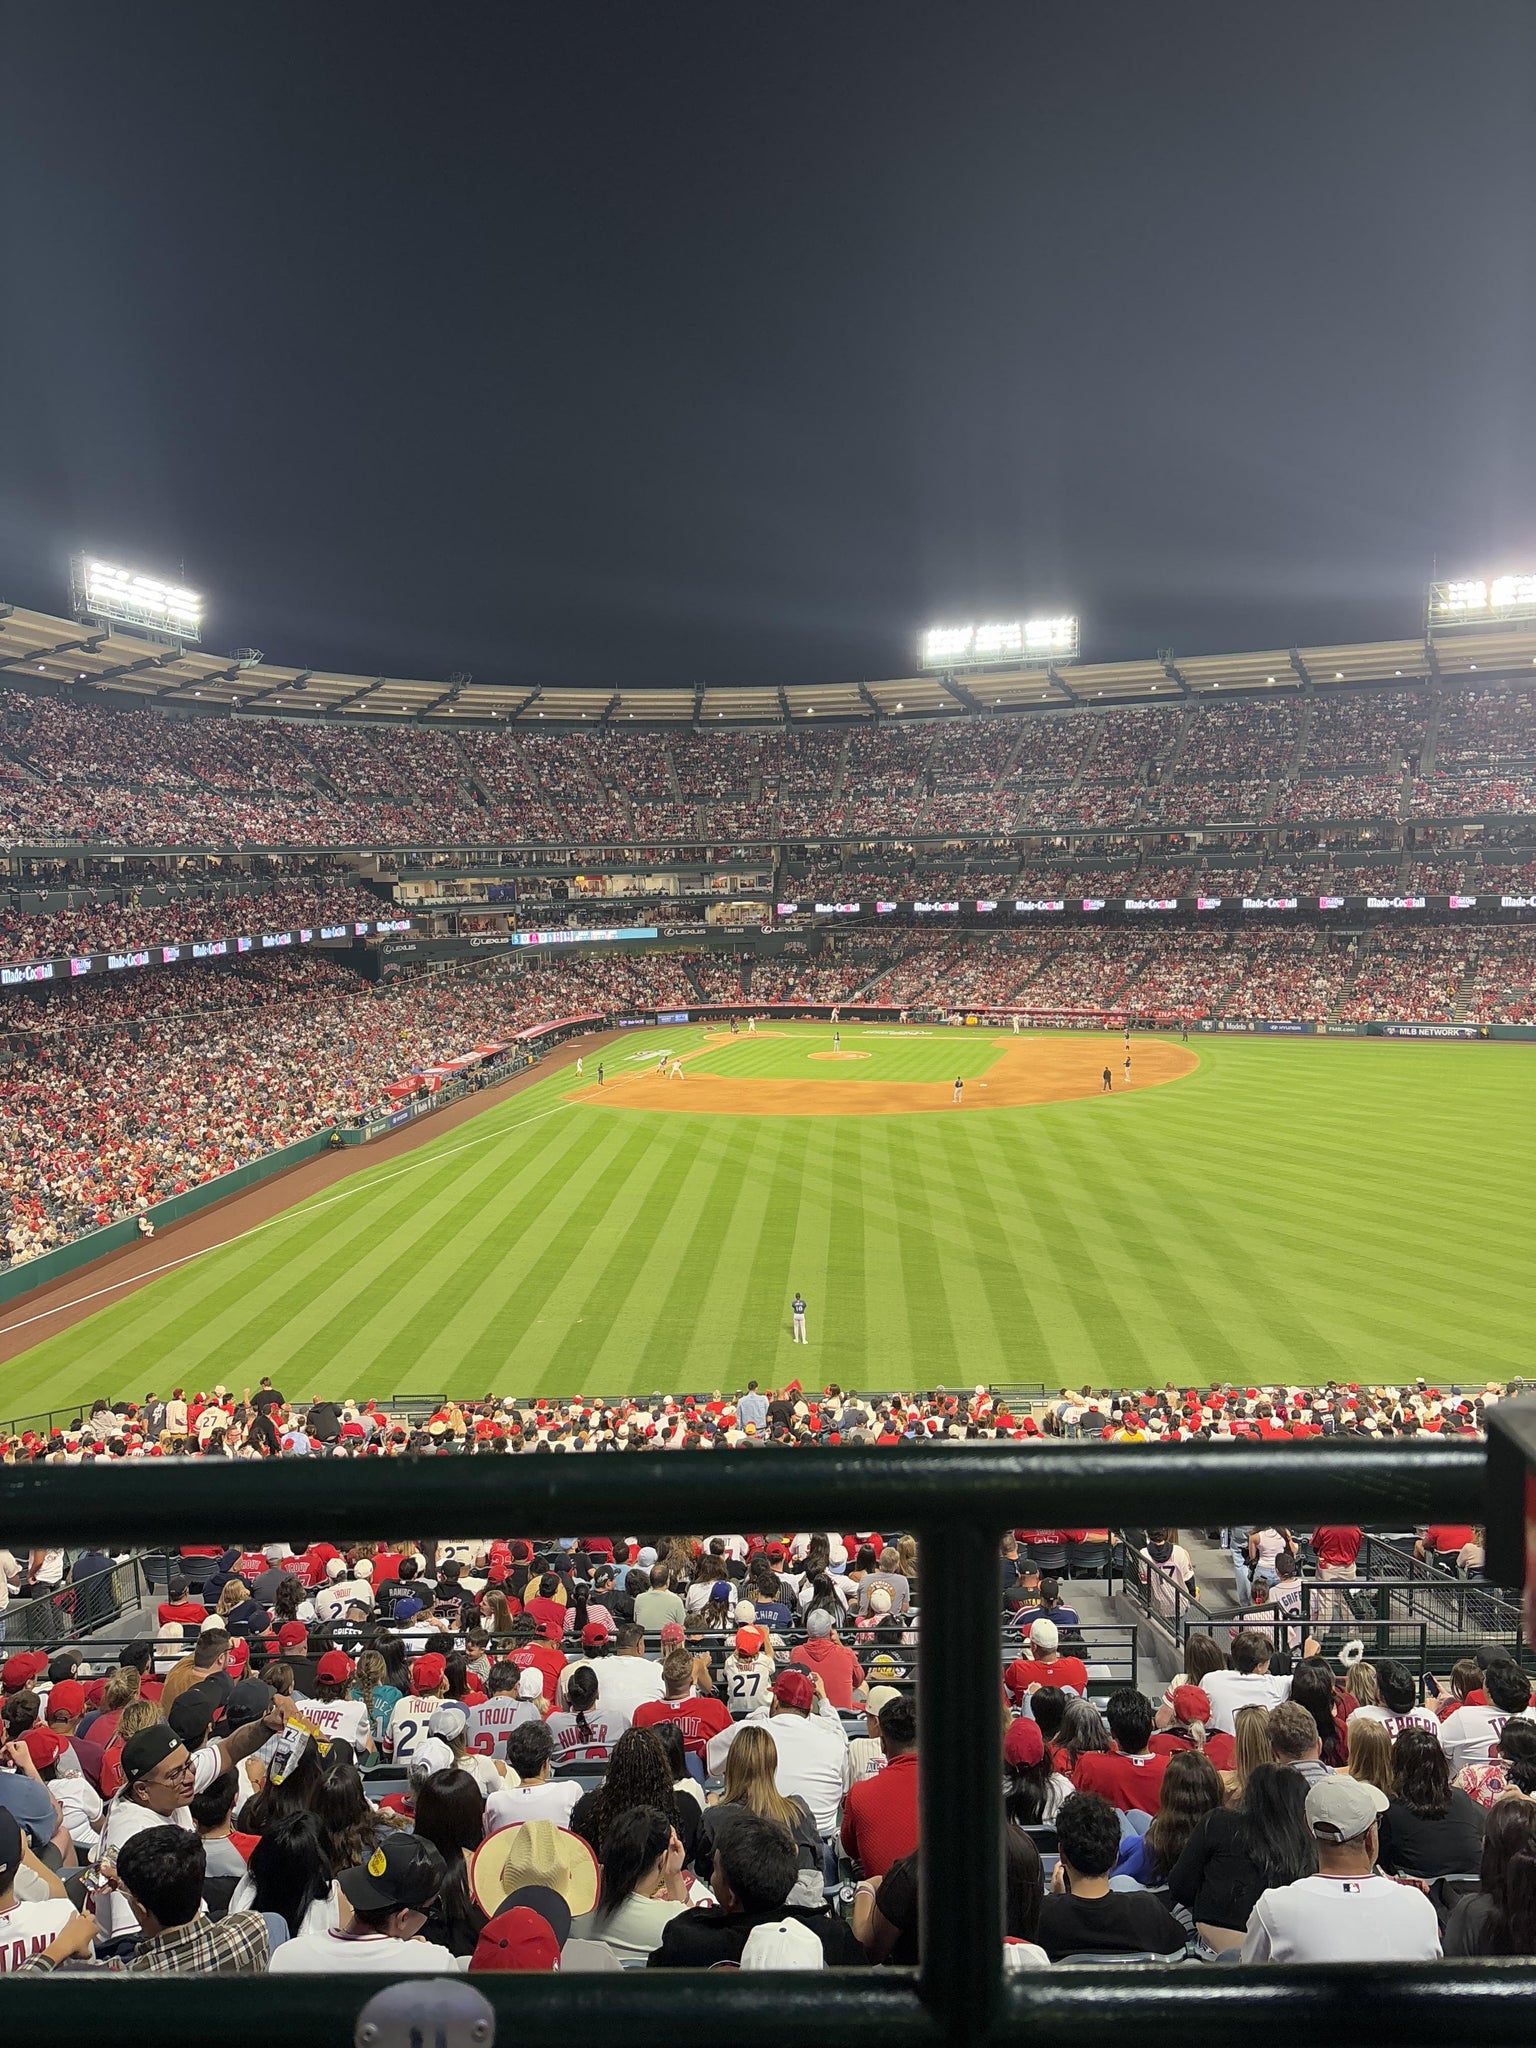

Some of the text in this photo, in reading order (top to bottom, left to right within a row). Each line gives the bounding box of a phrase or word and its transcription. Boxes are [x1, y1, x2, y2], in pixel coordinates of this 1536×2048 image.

[1125, 899, 1145, 909] Made
[1243, 898, 1264, 908] Made
[1368, 897, 1390, 907] Made
[1501, 896, 1526, 907] Made
[392, 944, 417, 952] LEXUS
[1, 968, 23, 984] Made
[1226, 1022, 1246, 1031] Modelo
[203, 1416, 217, 1427] 27
[241, 1560, 261, 1570] ROUT
[284, 1562, 310, 1573] TROUT
[333, 1588, 352, 1600] TROUT
[389, 1588, 416, 1598] RAMIREZ
[755, 1610, 779, 1621] CHIRO
[736, 1663, 756, 1673] TROUT
[732, 1674, 760, 1697] 27
[478, 1708, 517, 1726] TROUT
[558, 1724, 608, 1748] HUNER
